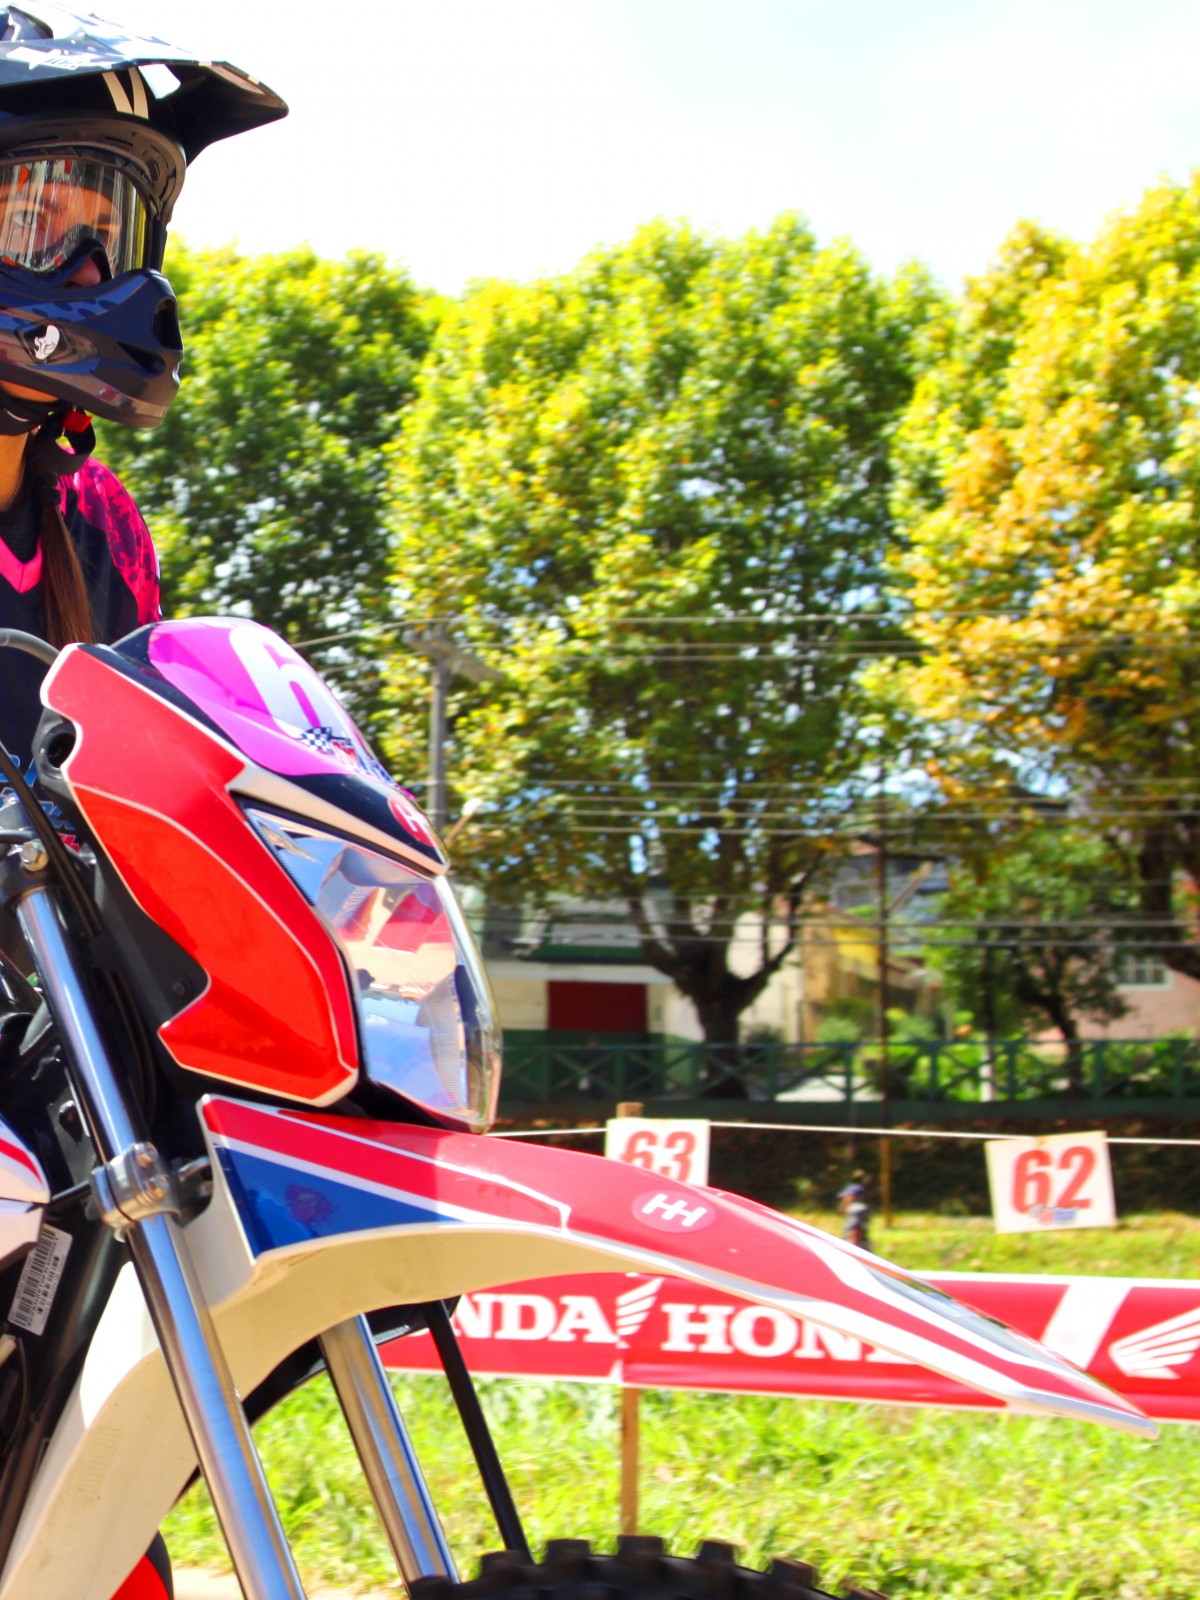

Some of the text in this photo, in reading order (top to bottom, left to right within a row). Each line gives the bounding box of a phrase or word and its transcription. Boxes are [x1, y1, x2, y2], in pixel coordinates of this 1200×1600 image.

[621, 1130, 696, 1183] 63
[1010, 1145, 1097, 1214] 62
[407, 1293, 920, 1364] NDA HON
